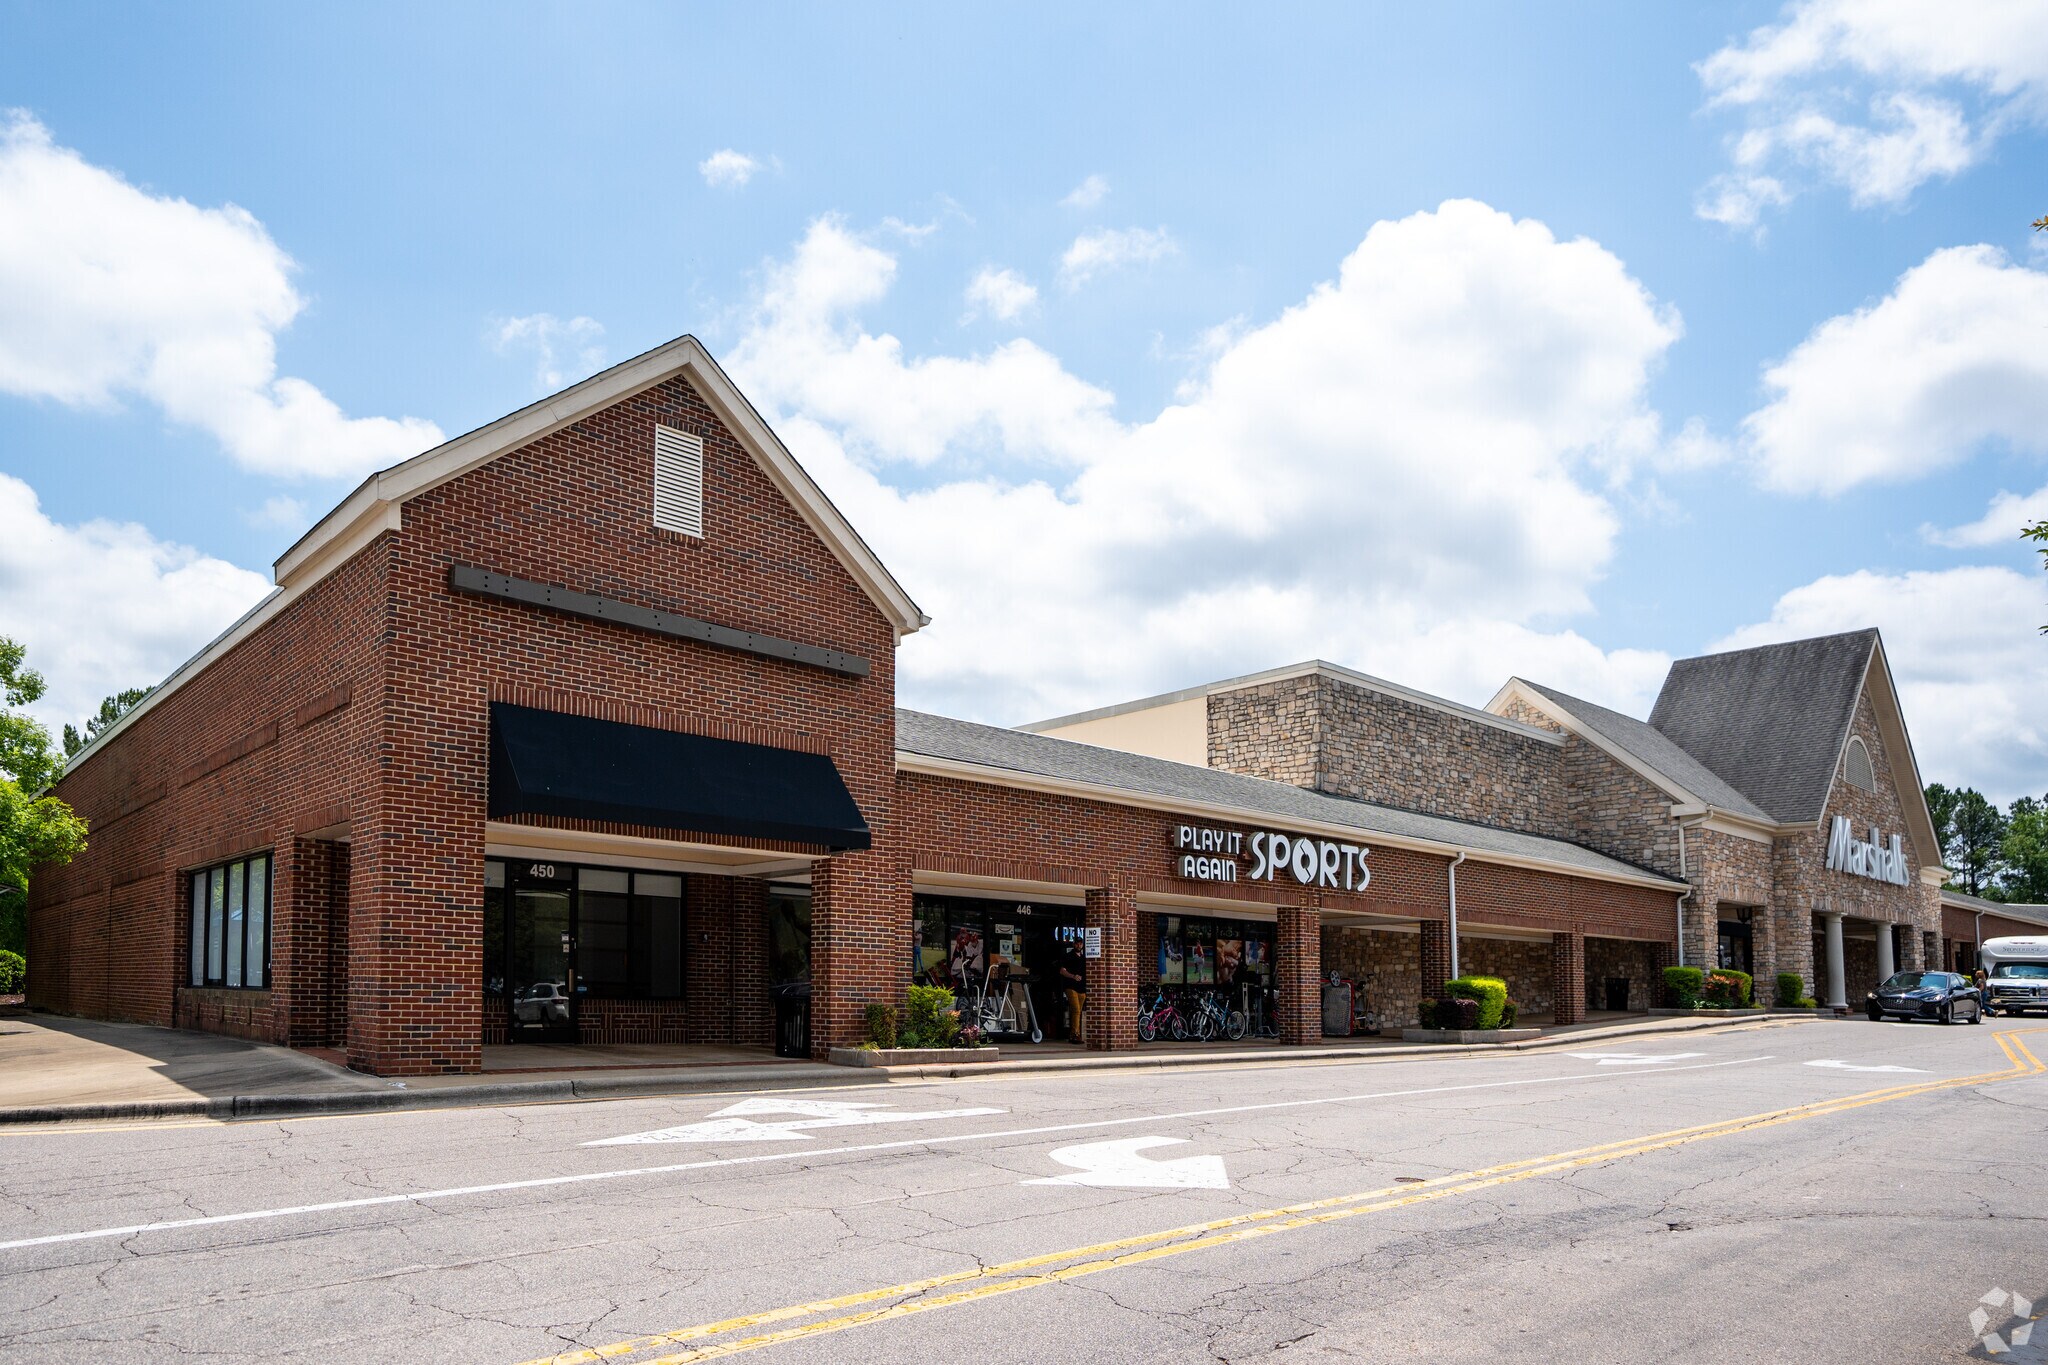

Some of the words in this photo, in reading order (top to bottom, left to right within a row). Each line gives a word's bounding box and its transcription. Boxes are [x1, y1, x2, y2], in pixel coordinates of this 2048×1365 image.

[1179, 825, 1224, 853] PLAY
[1227, 831, 1243, 855] IT
[1826, 815, 1910, 888] Marshalls
[530, 864, 555, 878] 450
[1183, 855, 1237, 883] AGAIN
[1250, 831, 1371, 893] SPORTS
[1016, 905, 1032, 915] 446
